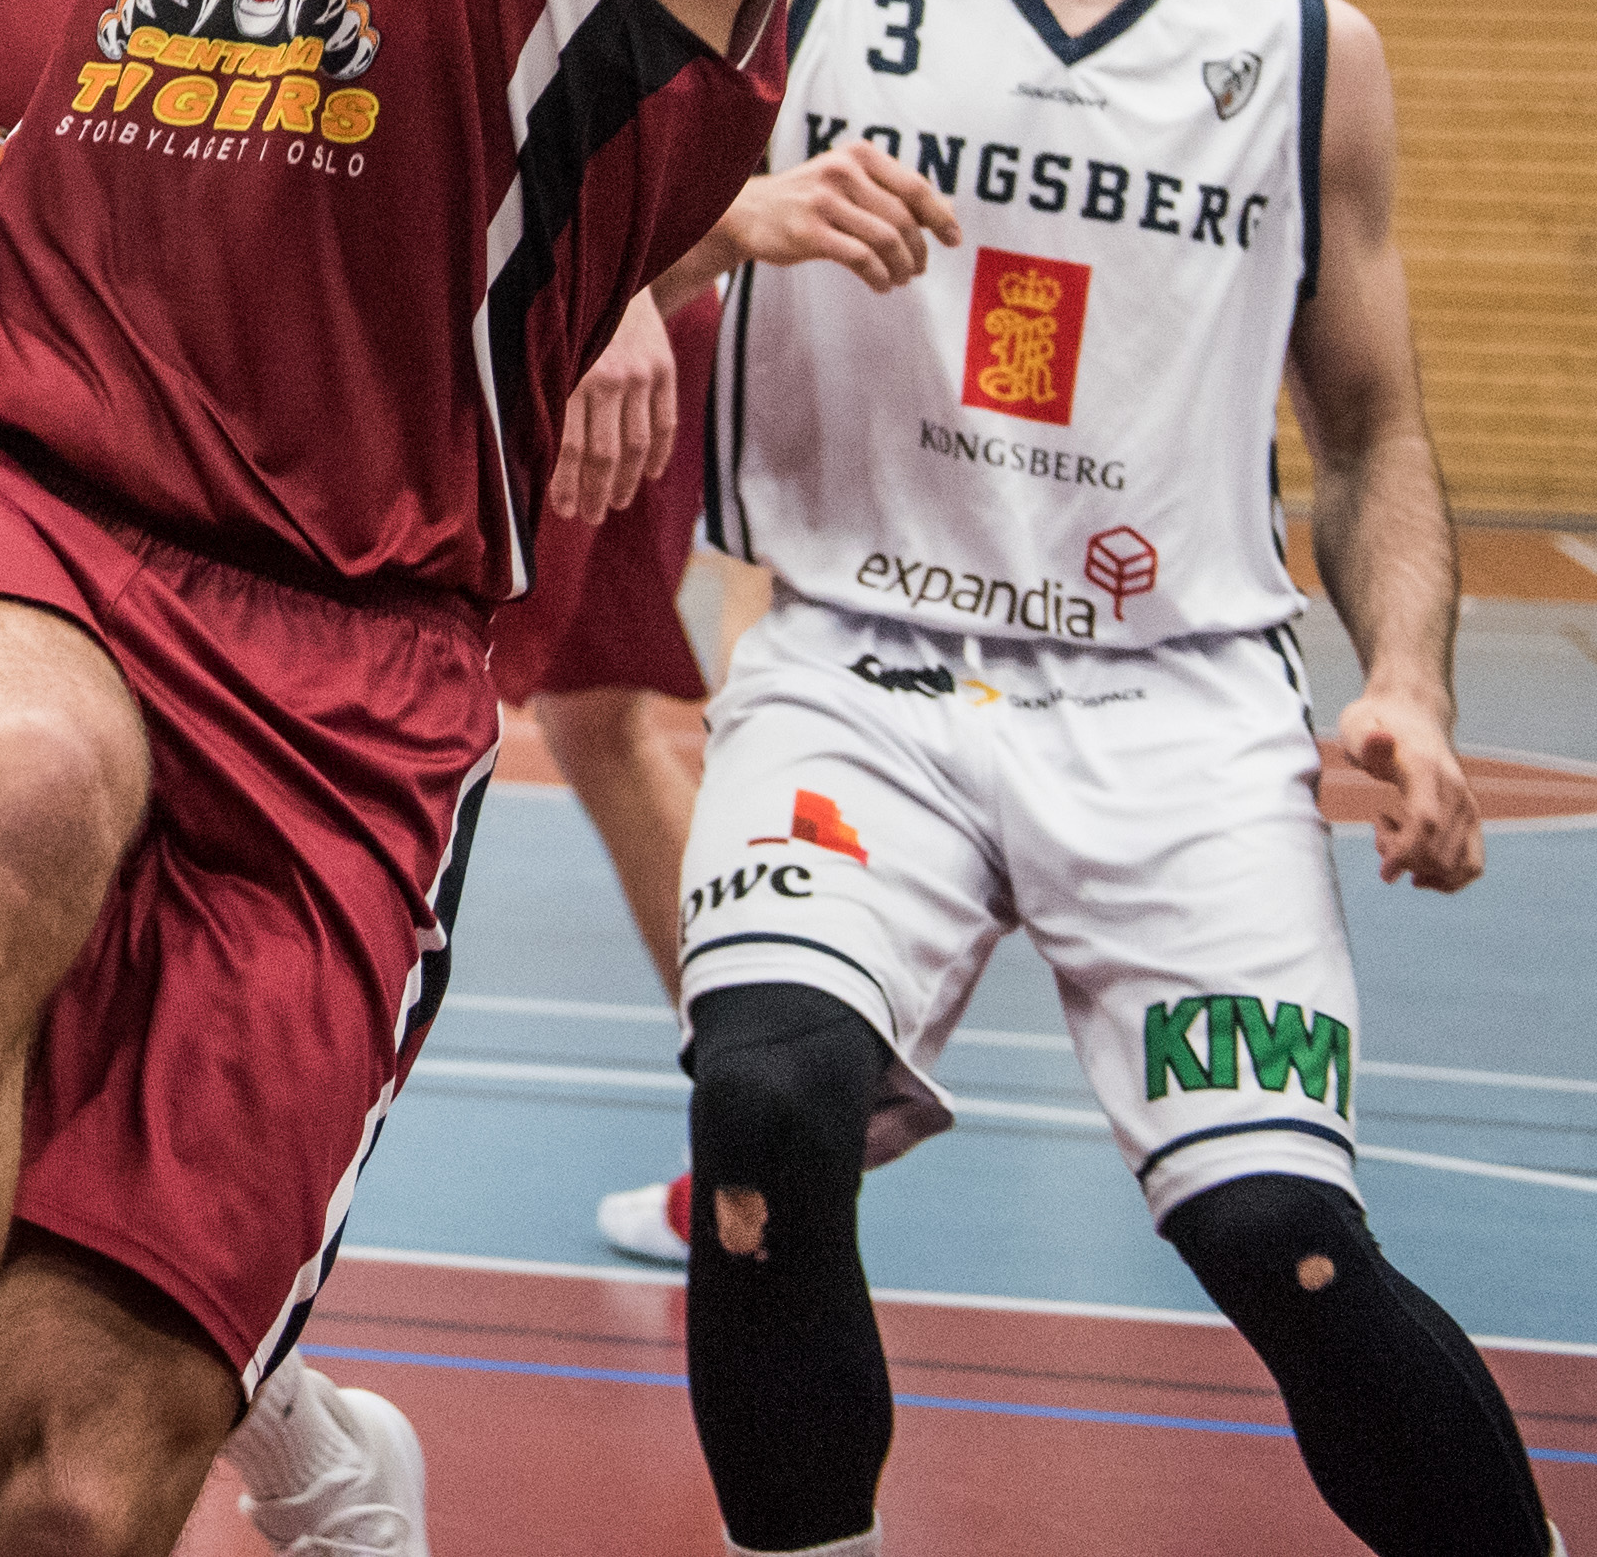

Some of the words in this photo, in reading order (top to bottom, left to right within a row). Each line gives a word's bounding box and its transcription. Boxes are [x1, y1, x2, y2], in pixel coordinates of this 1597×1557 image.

[71, 60, 381, 144] TIGERS
[286, 140, 365, 178] OSLO
[856, 552, 1097, 641] expandia
[1144, 993, 1351, 1123] KIWI
